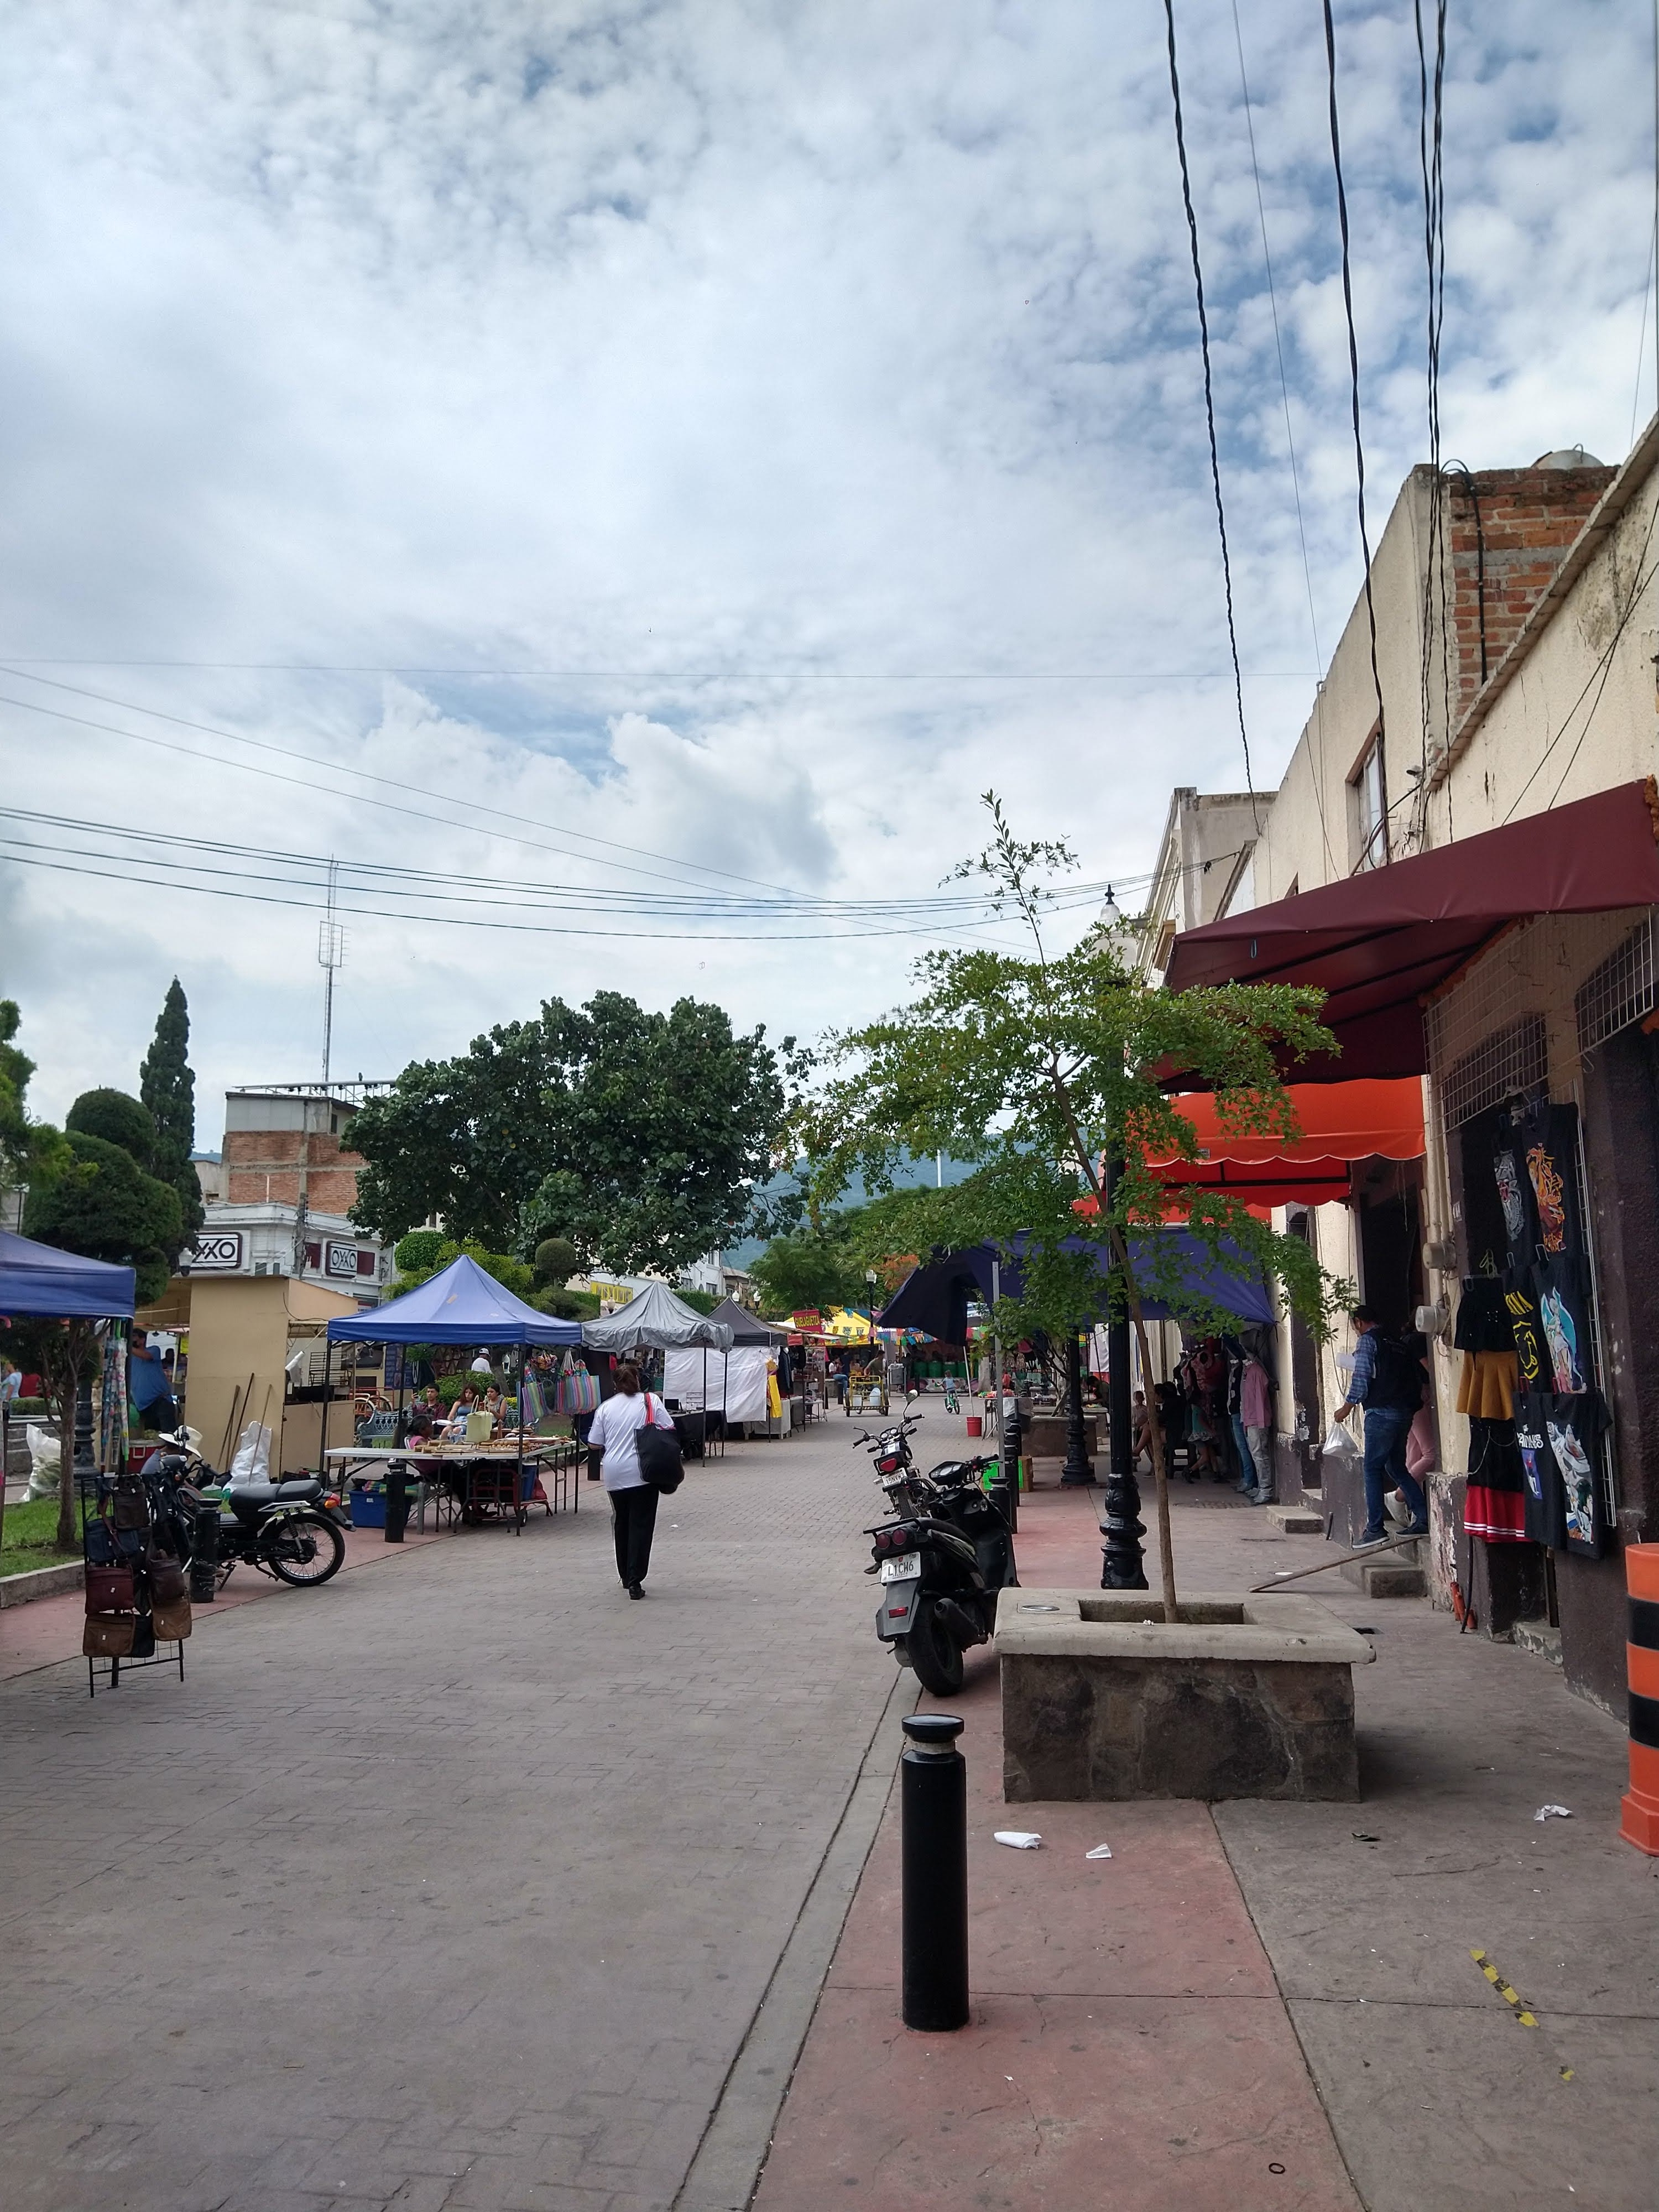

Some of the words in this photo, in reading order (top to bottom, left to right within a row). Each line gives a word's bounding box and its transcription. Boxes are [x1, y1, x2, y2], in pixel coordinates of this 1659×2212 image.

[192, 1239, 236, 1262] XXO
[332, 1250, 357, 1269] OXXO
[795, 1315, 820, 1328] GUELAGUETZA
